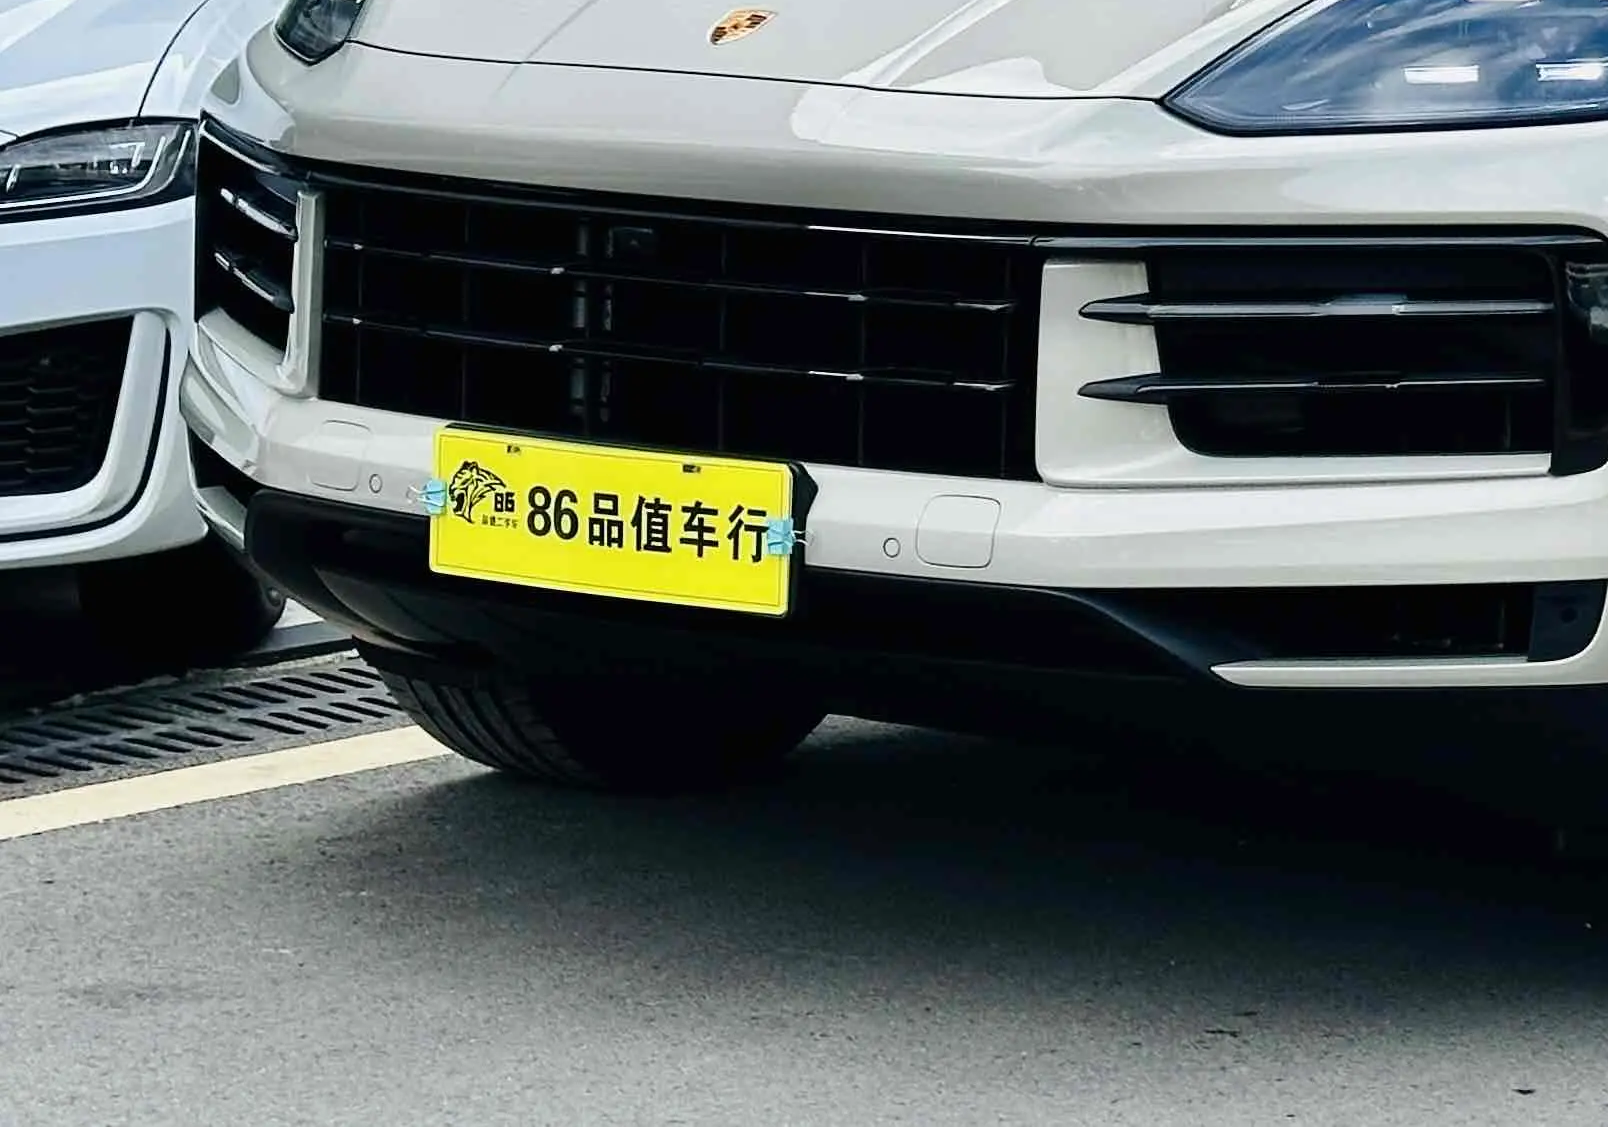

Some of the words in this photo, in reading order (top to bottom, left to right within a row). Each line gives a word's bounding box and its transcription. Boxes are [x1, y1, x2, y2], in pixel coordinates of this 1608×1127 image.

[494, 492, 515, 513] 86
[527, 486, 769, 564] 86品值车行
